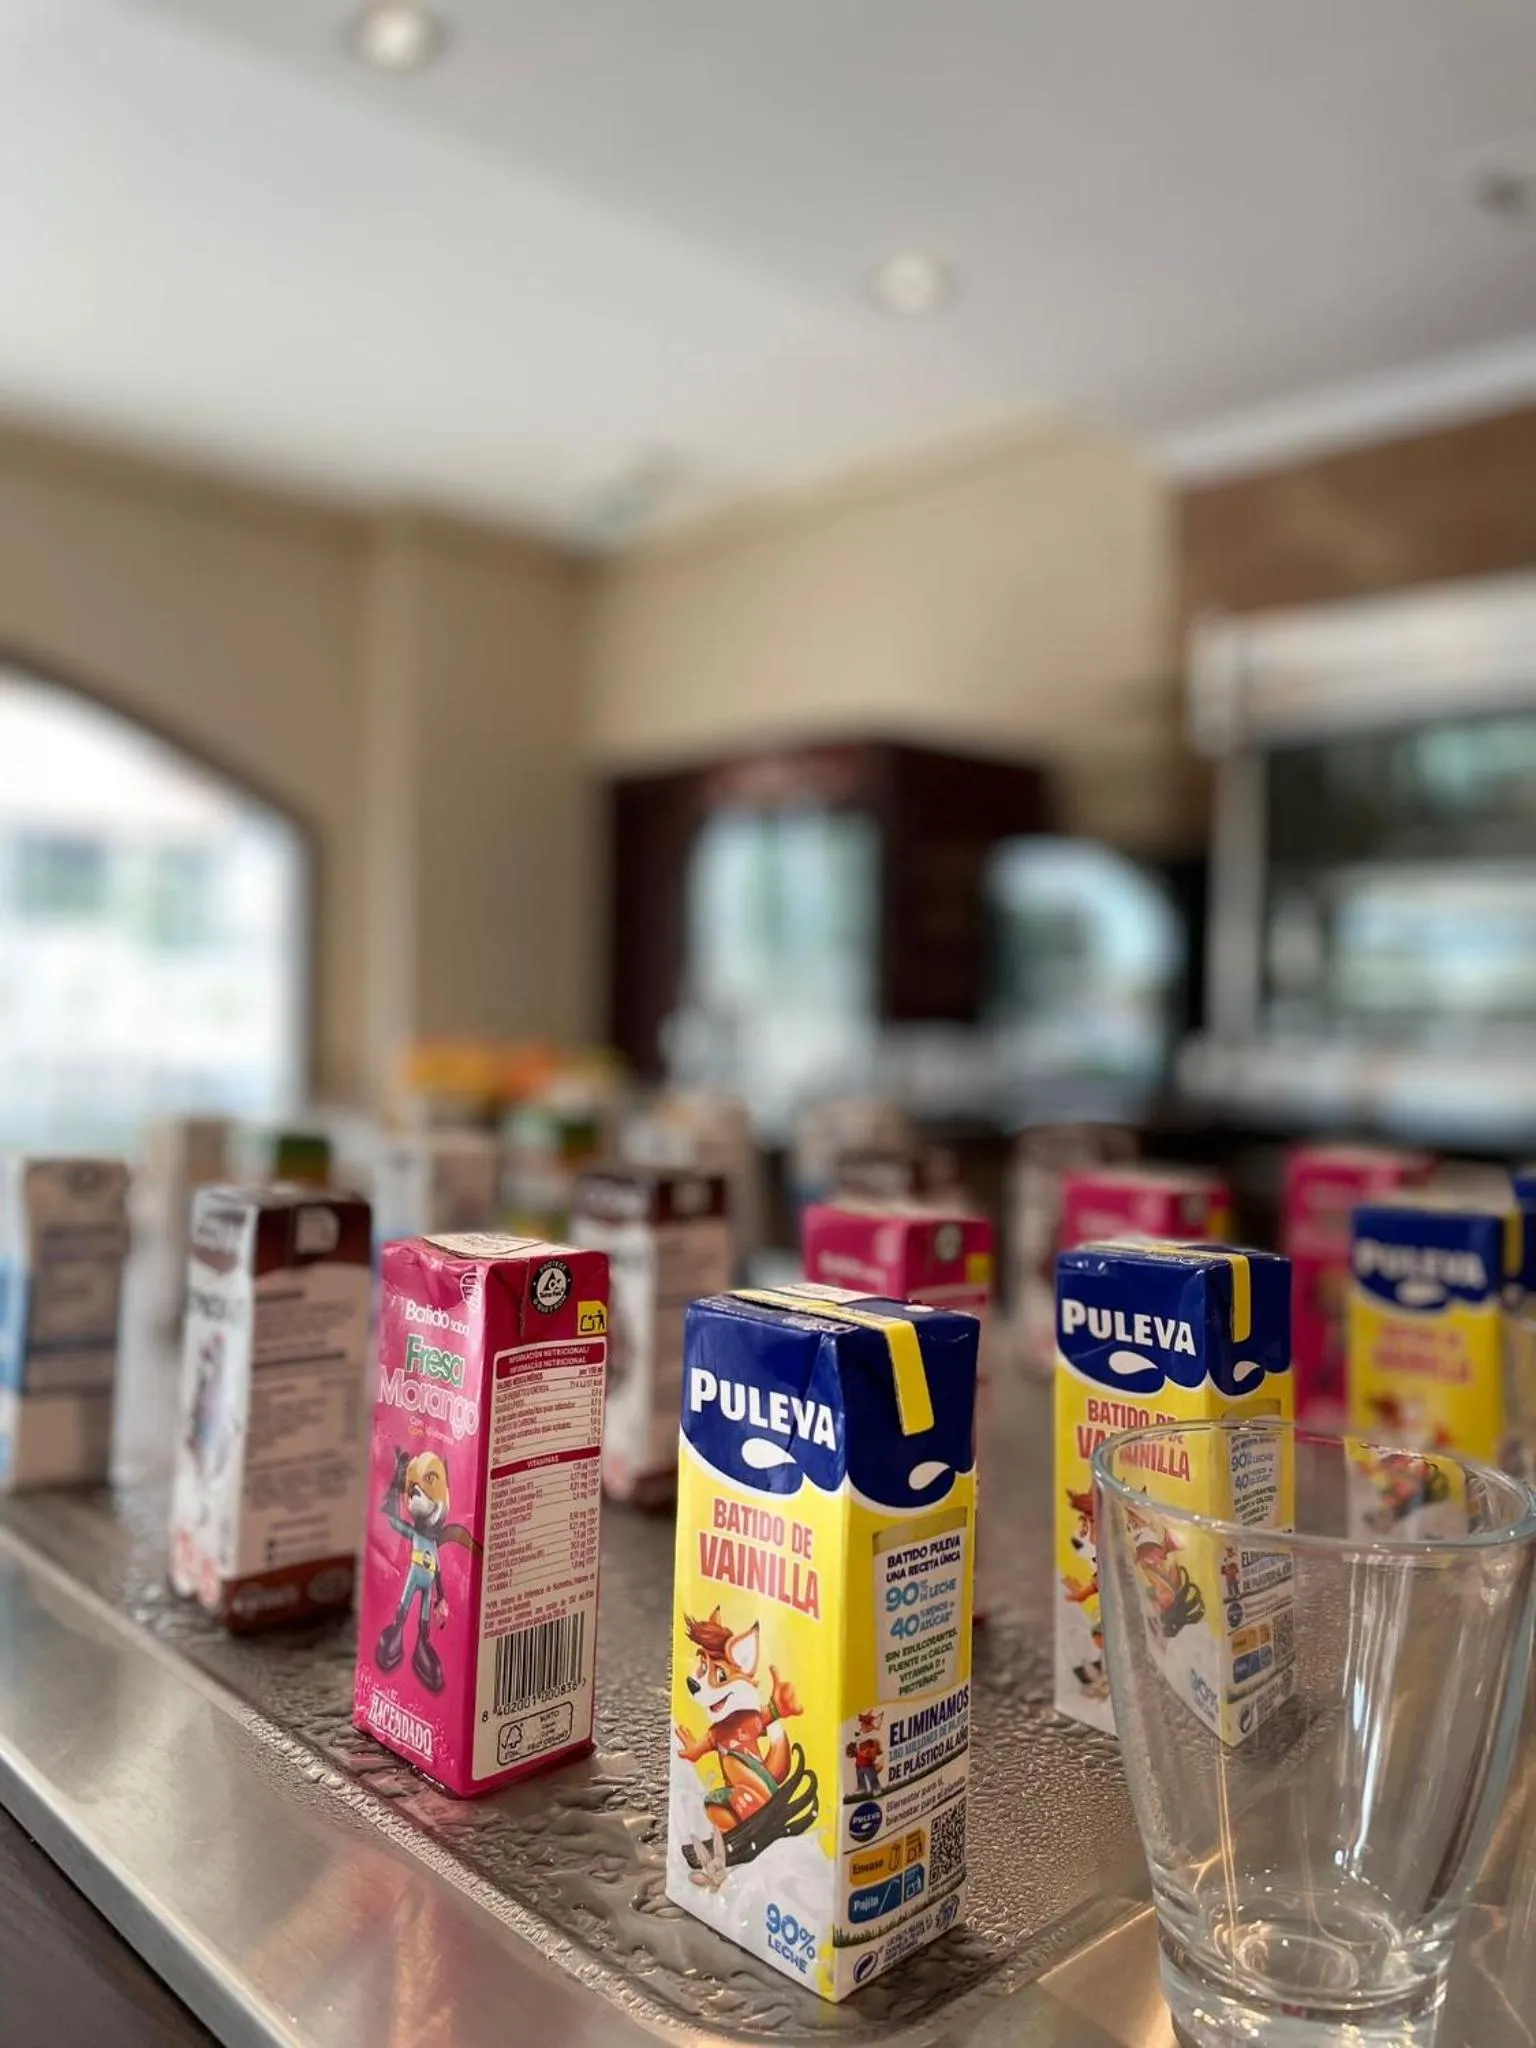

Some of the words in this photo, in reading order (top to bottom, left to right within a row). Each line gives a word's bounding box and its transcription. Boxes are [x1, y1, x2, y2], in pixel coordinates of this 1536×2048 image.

[404, 1299, 450, 1329] Batido
[1062, 1298, 1197, 1357] PULEVA
[405, 1333, 466, 1389] Fresa
[378, 1364, 480, 1440] Morango
[690, 1366, 837, 1451] PULEVA
[1087, 1398, 1149, 1429] BATIDO
[713, 1497, 785, 1547] BATIDO
[791, 1521, 813, 1560] DE
[887, 1546, 928, 1569] BATIDO
[929, 1534, 961, 1556] PULEVA
[700, 1531, 820, 1621] VAINILLA
[886, 1569, 907, 1583] UNA
[908, 1559, 940, 1577] RECETA
[885, 1580, 919, 1612] 90
[928, 1577, 957, 1597] LECHE
[890, 1613, 920, 1640] 40
[885, 1648, 901, 1663] SIN
[888, 1654, 920, 1675] FUENTE
[899, 1663, 934, 1684] VITAMINA
[481, 1710, 489, 1723] 8
[497, 1695, 537, 1717] 402001
[541, 1683, 578, 1702] 000836
[889, 1684, 969, 1747] ELIMINAMOS
[368, 1693, 434, 1758] HACENDADO
[888, 1765, 902, 1782] DE
[904, 1745, 944, 1778] PLÁSTICO
[944, 1737, 955, 1754] AL
[852, 1809, 881, 1825] PULEVA
[852, 1857, 884, 1875] Envase
[853, 1894, 879, 1912] Pajita
[766, 1903, 815, 1960] 90%
[768, 1933, 808, 1974] LECHE
